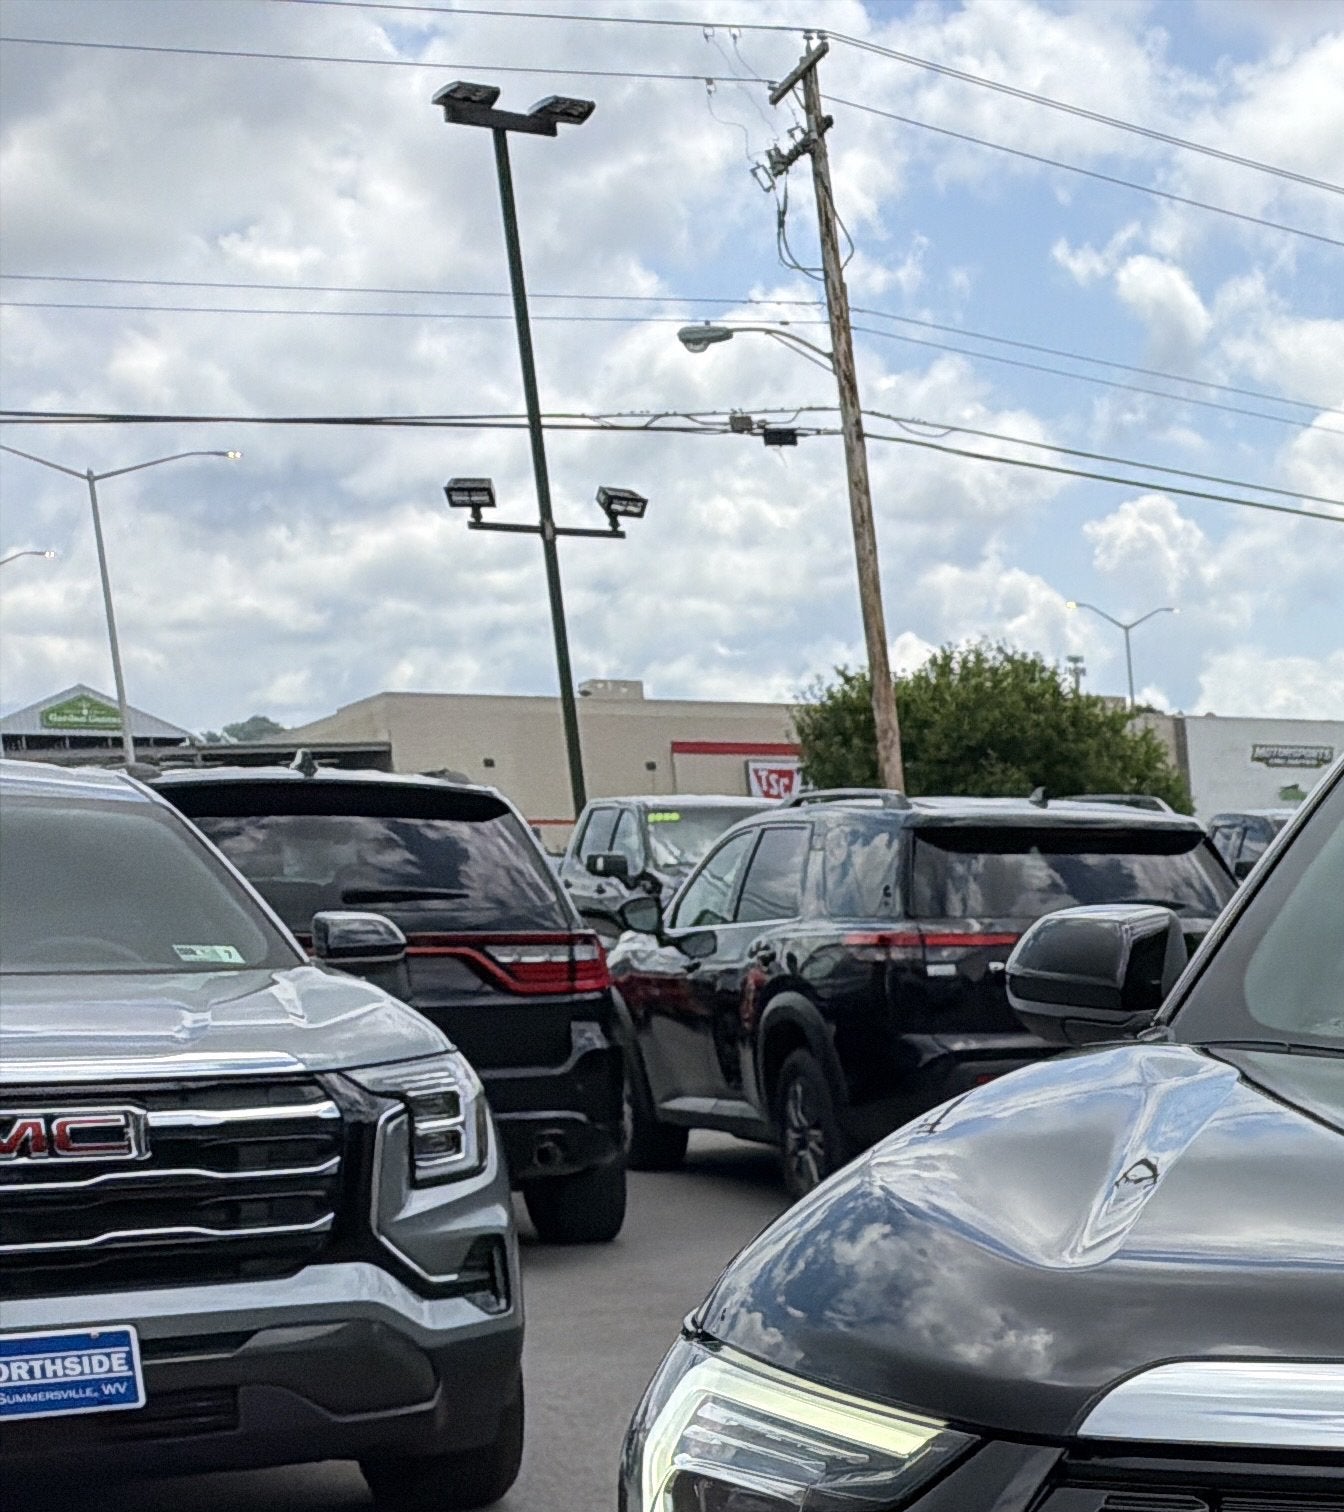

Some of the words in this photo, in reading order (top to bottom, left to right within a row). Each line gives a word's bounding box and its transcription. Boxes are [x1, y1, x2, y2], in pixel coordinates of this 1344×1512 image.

[757, 770, 790, 796] TSC
[0, 1114, 132, 1158] MC
[101, 1381, 128, 1396] WV
